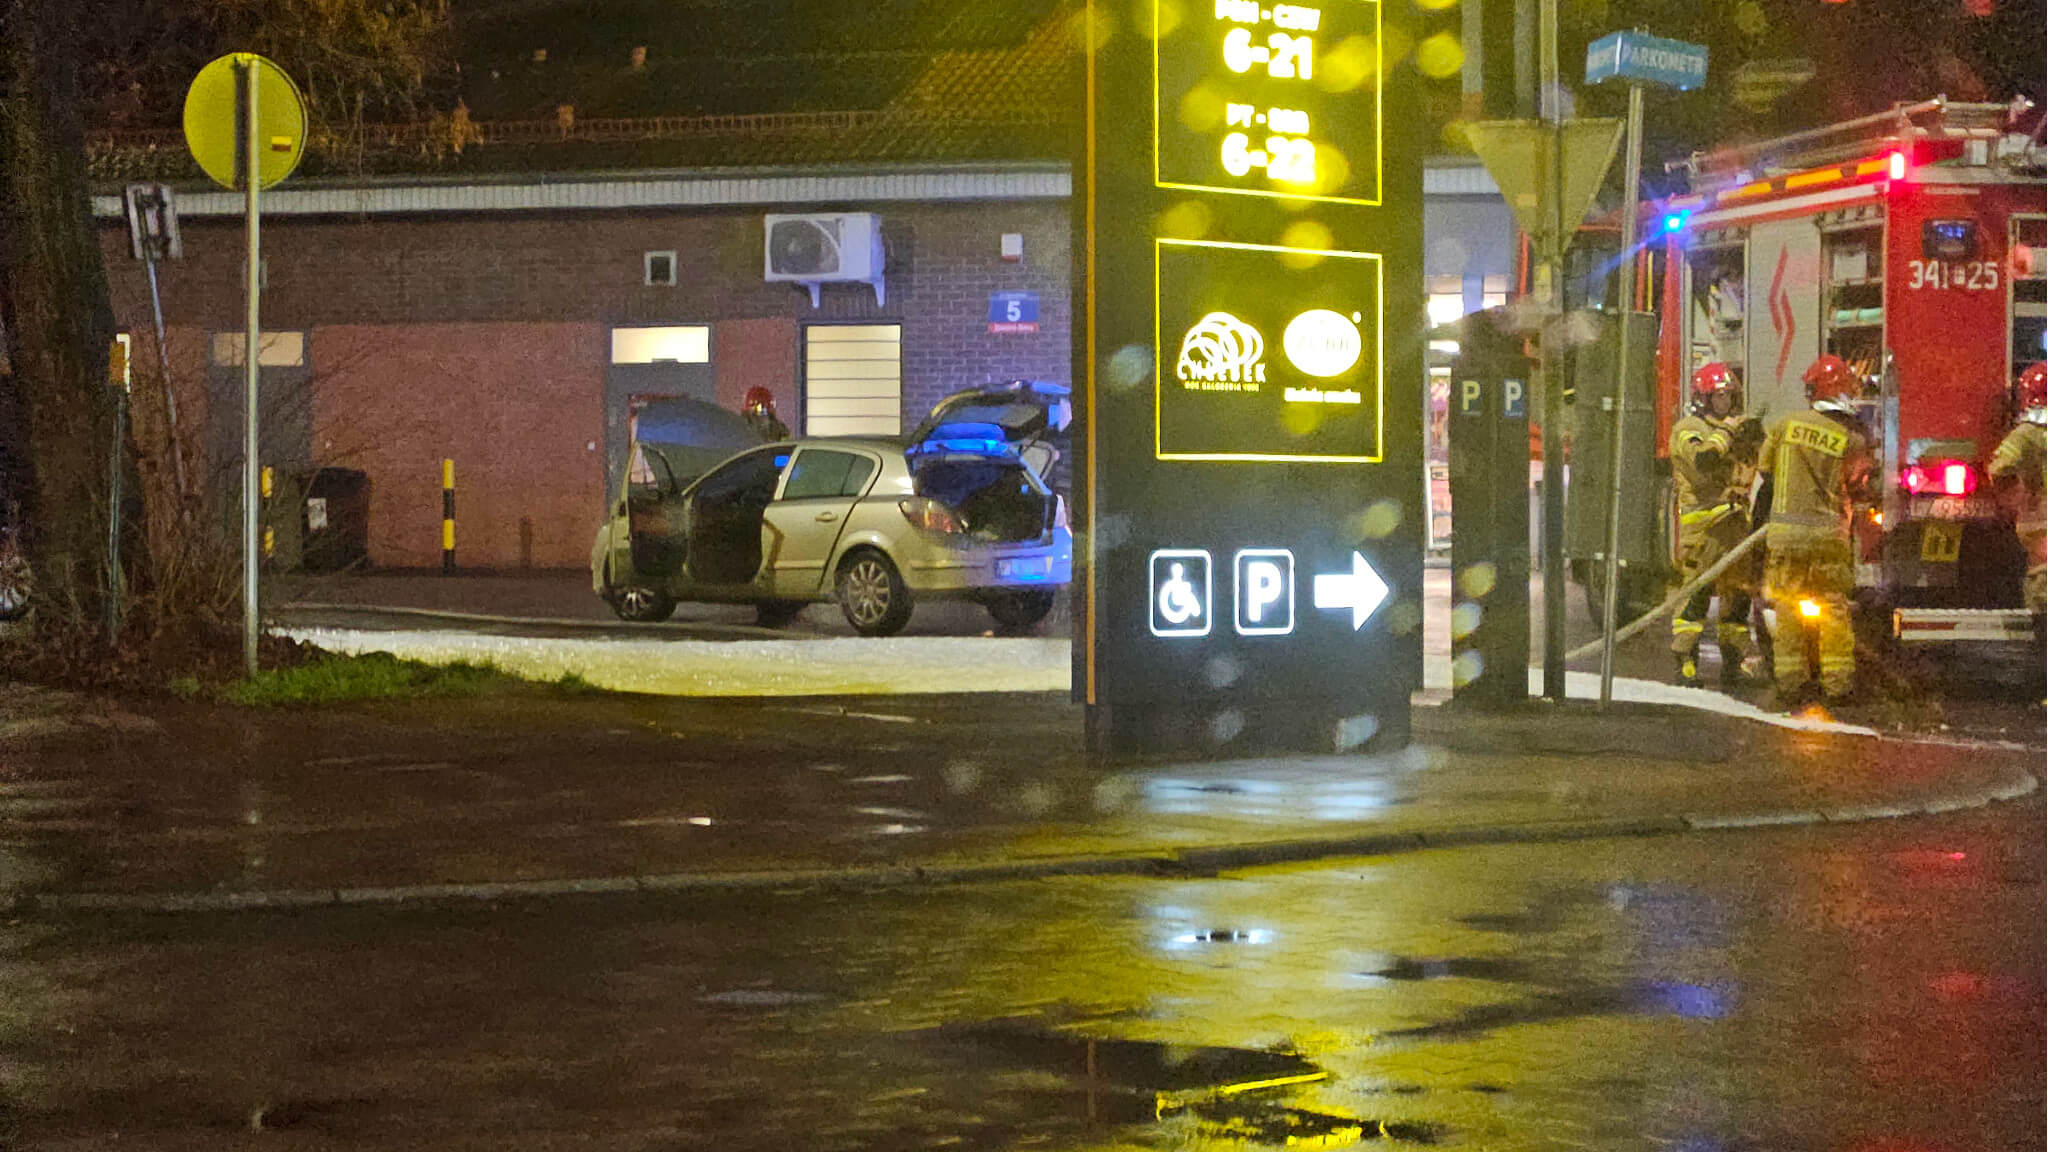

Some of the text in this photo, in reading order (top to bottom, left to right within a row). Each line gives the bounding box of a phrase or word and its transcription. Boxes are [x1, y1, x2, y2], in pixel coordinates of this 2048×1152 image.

[1223, 28, 1313, 80] 6-21
[1226, 103, 1254, 127] PT
[1007, 300, 1021, 322] 5
[1462, 381, 1480, 411] P
[1505, 381, 1522, 411] P
[1248, 561, 1282, 622] P
